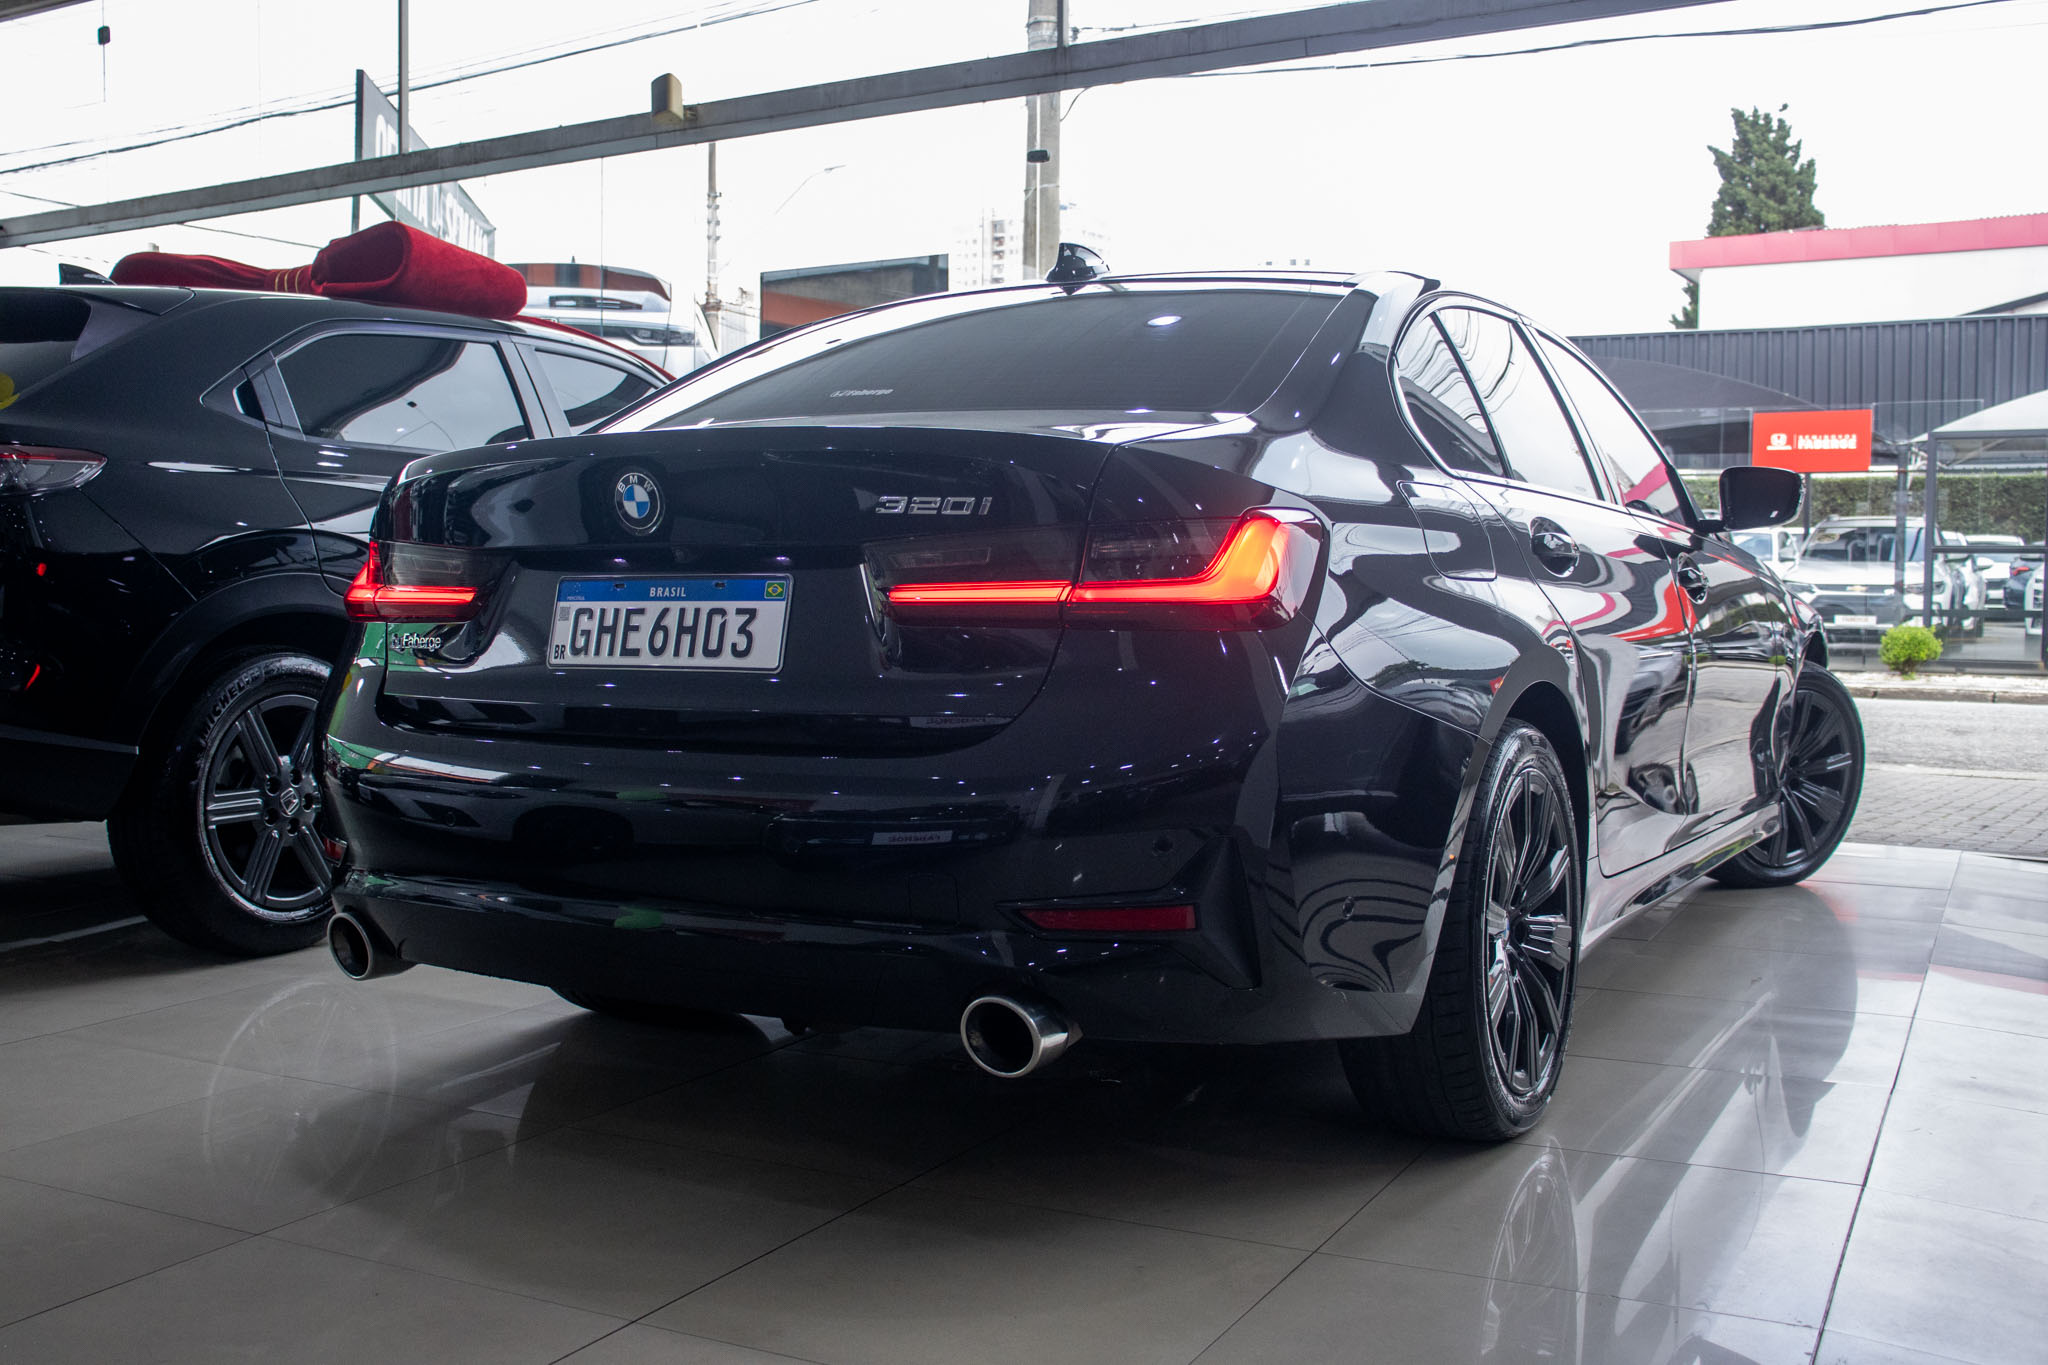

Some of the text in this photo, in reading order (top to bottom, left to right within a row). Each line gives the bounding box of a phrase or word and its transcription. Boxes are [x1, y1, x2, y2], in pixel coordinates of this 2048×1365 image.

[617, 475, 653, 493] BMW
[875, 496, 993, 515] 320i
[649, 587, 687, 598] BRASIL
[568, 607, 758, 658] GHE6H03
[553, 644, 566, 660] BR
